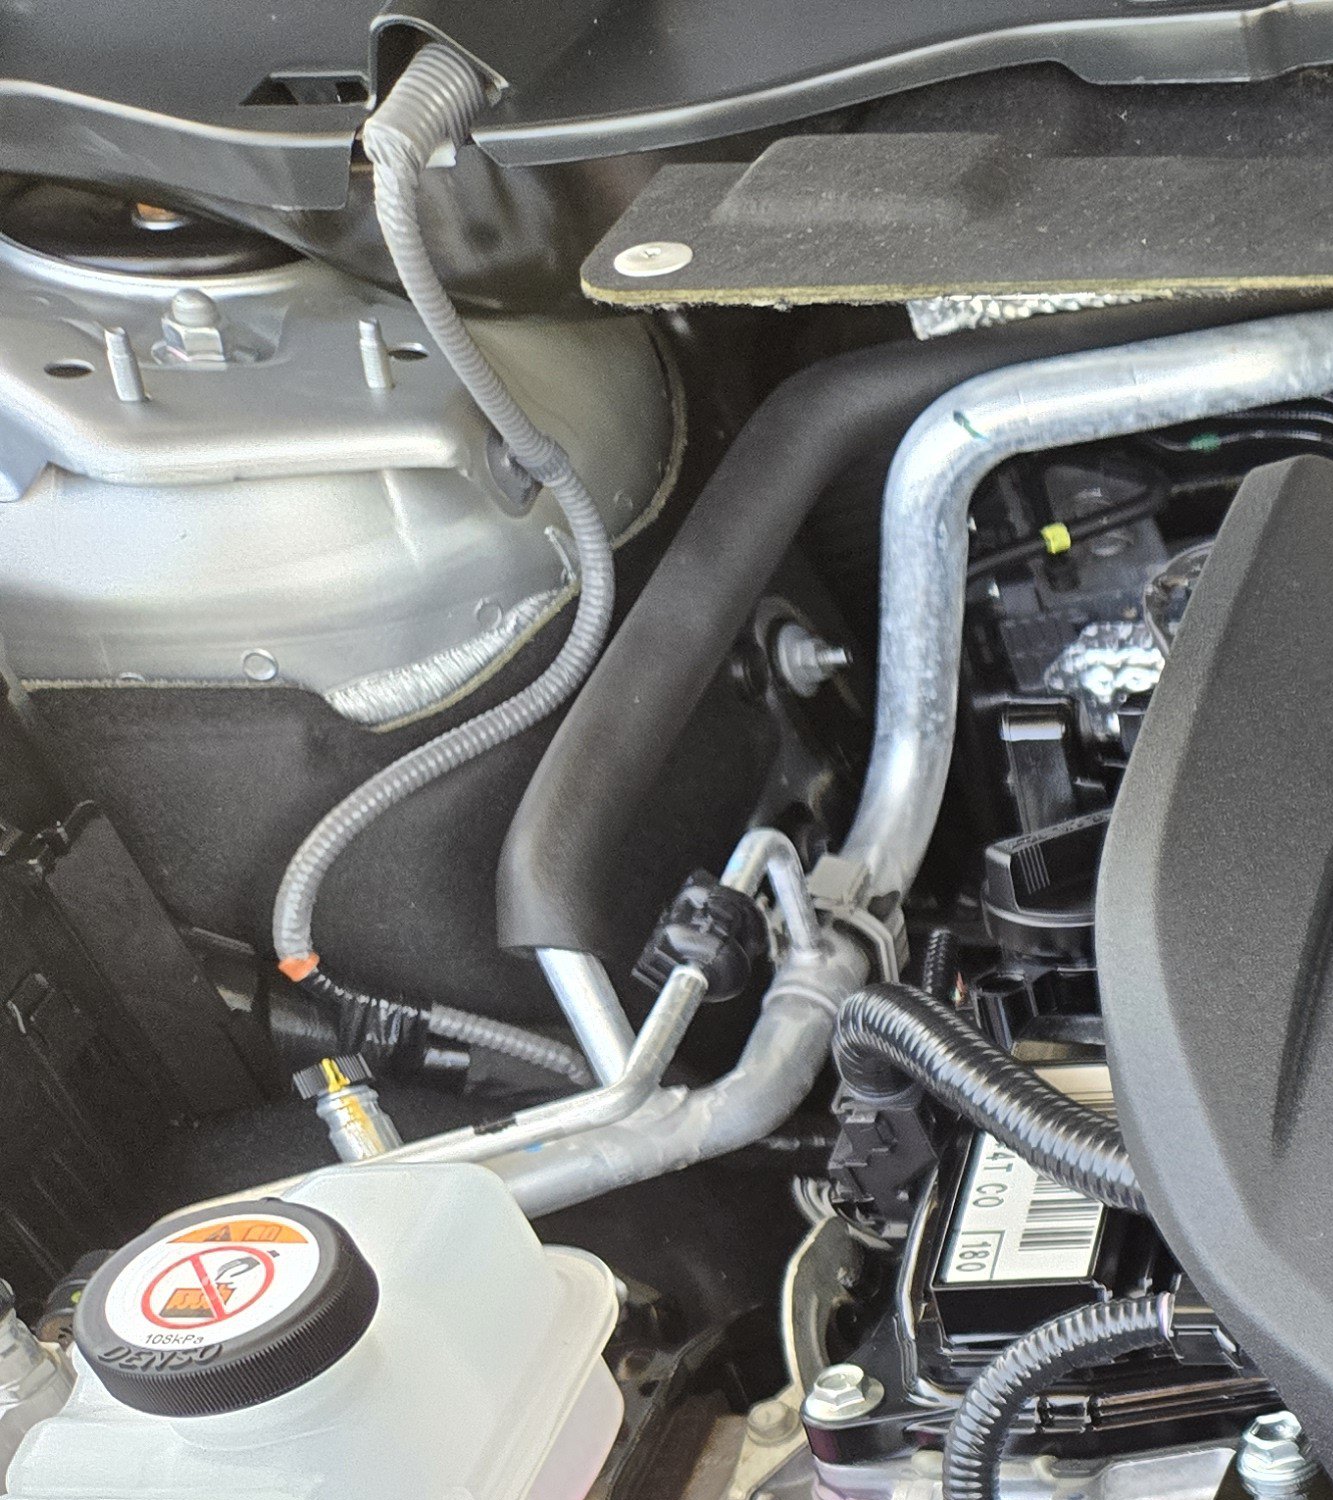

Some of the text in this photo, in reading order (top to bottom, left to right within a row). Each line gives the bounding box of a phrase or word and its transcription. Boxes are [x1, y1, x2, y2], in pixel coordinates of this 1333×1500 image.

[955, 1240, 993, 1273] 180
[144, 1333, 205, 1345] 108kPa
[97, 1342, 224, 1372] DENSO
